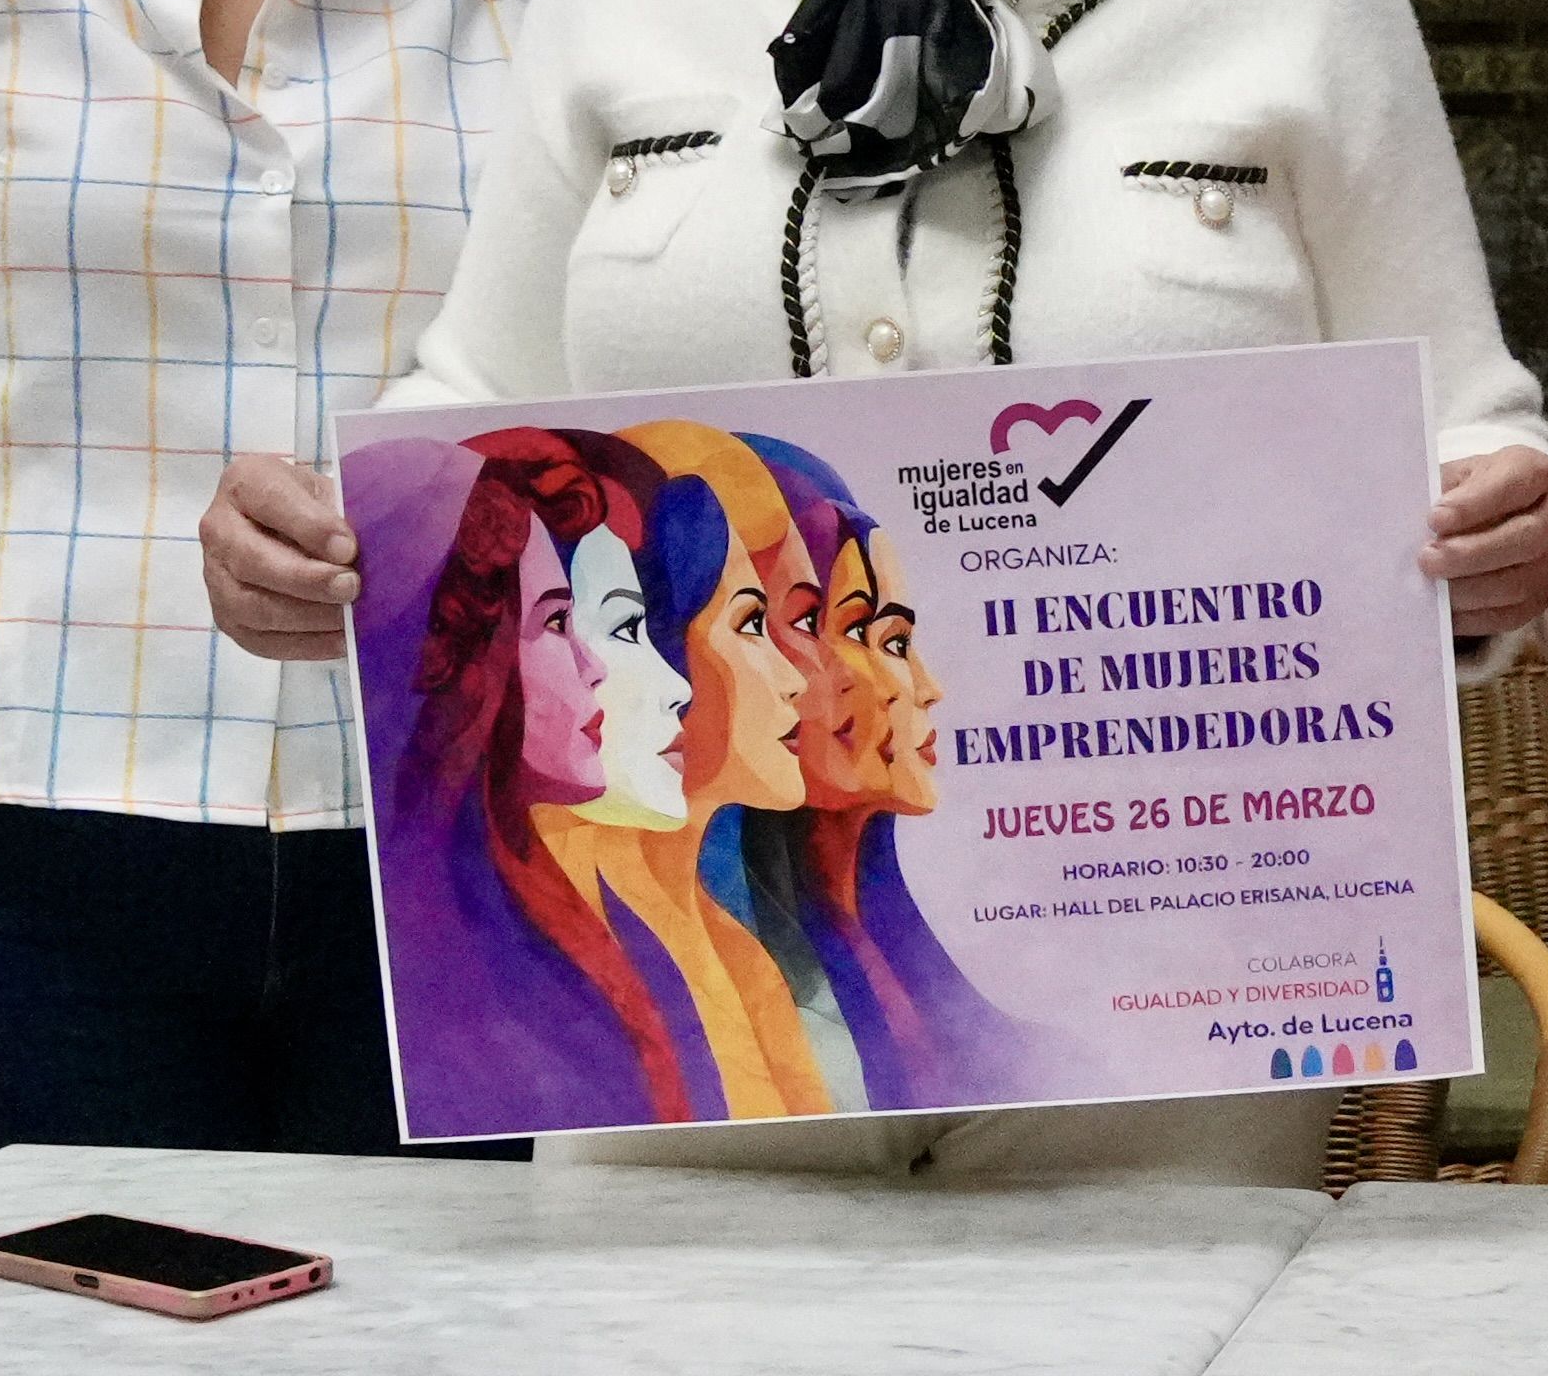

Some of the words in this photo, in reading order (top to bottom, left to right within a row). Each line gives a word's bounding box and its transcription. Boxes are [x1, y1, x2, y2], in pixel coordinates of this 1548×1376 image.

[899, 459, 1001, 489] mujeres
[1006, 463, 1023, 475] en
[913, 479, 1028, 516] igualdad
[924, 514, 950, 534] de
[959, 511, 1037, 532] Lucena
[960, 544, 1116, 572] ORGANIZA:
[985, 599, 1016, 636] II
[1036, 580, 1321, 633] ENCUENTRO
[1025, 658, 1085, 696] DE
[1101, 643, 1319, 691] MUJERES
[955, 702, 1393, 765] EMPRENDEDORAS
[984, 801, 1114, 839] JUEVES
[1129, 798, 1170, 830] 26
[1184, 794, 1230, 826] DE
[1243, 784, 1375, 822] MARZO
[1063, 859, 1170, 880] HORARIO:
[1177, 855, 1228, 873] 10:30
[1252, 849, 1310, 868] 20:00
[974, 904, 1046, 922] LUGAR:
[1053, 901, 1103, 916] HALL
[1108, 898, 1144, 914] DEL
[1150, 891, 1235, 910] PALACIO
[1241, 885, 1330, 905] ERISANA,
[1335, 880, 1414, 898] LUCENA
[1247, 952, 1357, 973] COLABORA
[1113, 990, 1222, 1011] IGUALDAD
[1228, 989, 1239, 1002] Y
[1246, 979, 1369, 1002] DIVERSIDAD
[1209, 1022, 1275, 1044] Ayto.
[1282, 1016, 1313, 1035] de
[1322, 1014, 1412, 1033] Lucena
